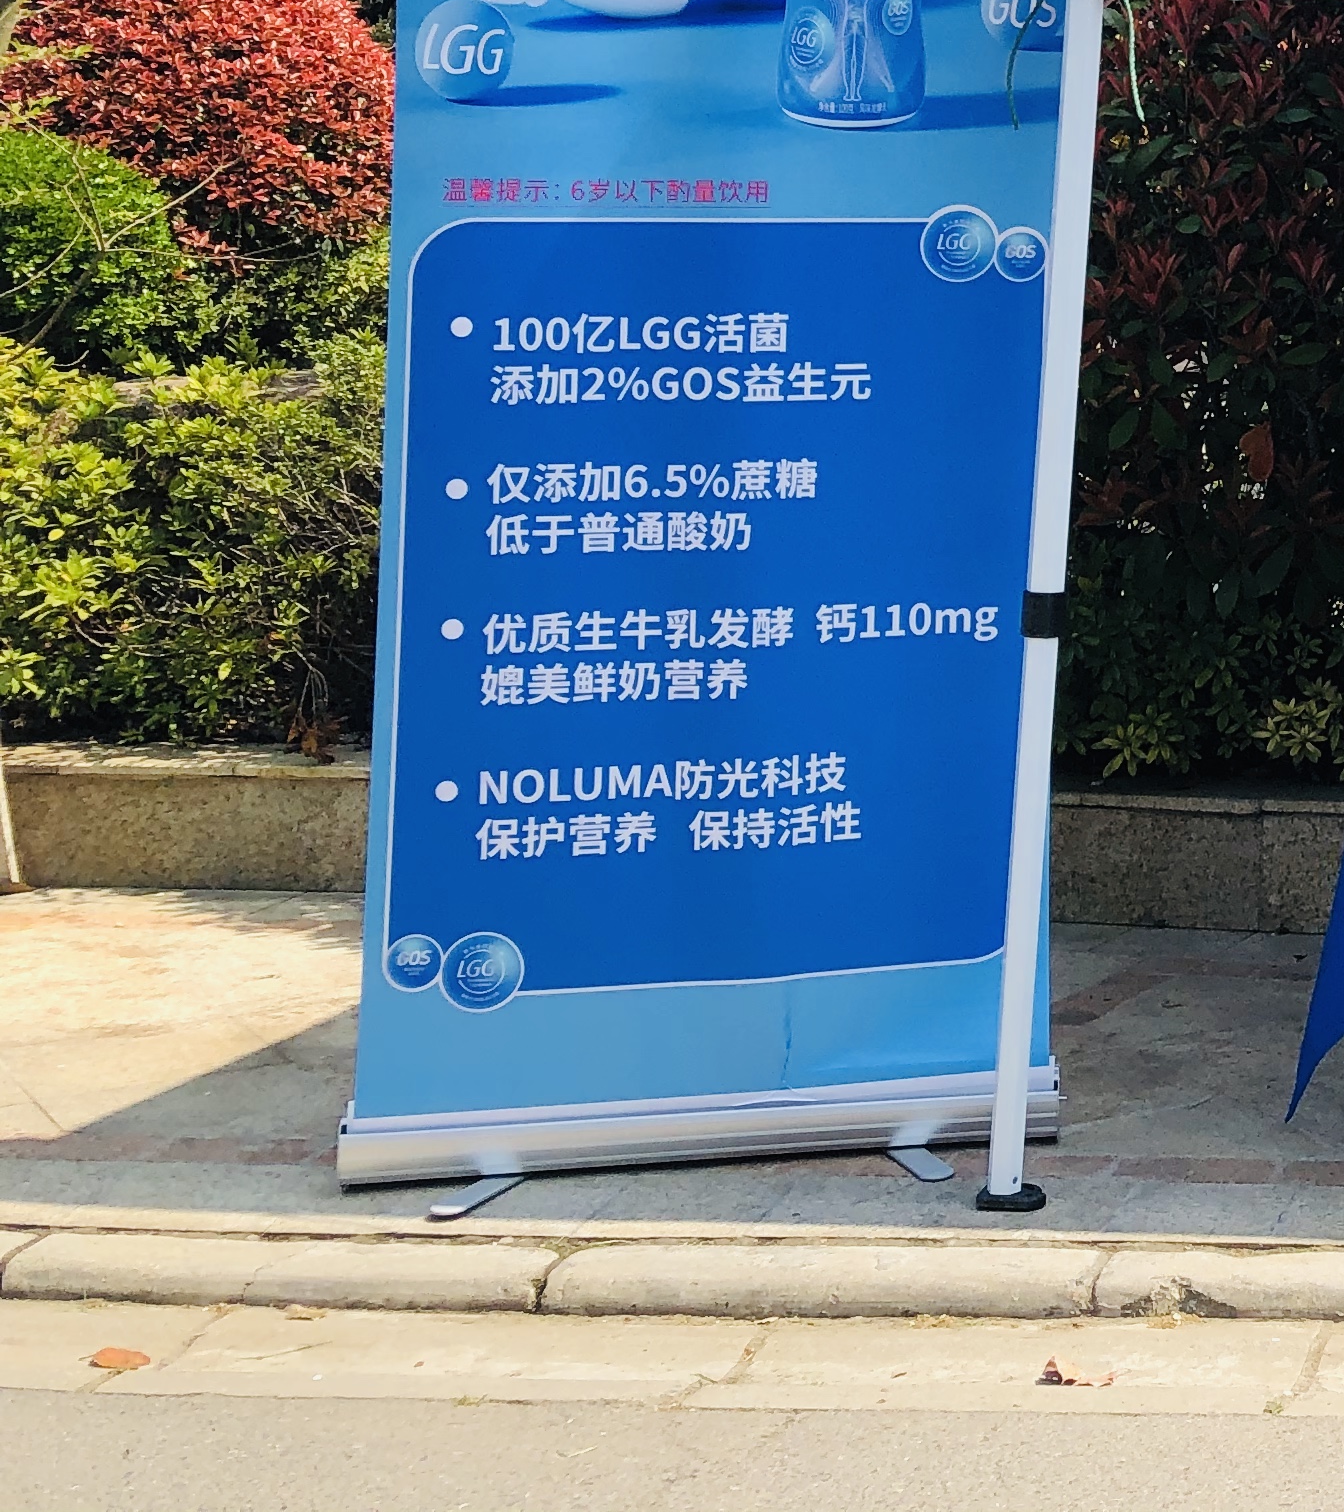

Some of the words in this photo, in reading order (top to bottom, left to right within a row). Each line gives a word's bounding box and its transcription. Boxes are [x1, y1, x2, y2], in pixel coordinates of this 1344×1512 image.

[423, 23, 506, 75] LGG
[791, 26, 819, 48] LGG
[491, 313, 790, 354] 100亿LGG活菌
[489, 361, 872, 407] 添加2%GOS益生元
[486, 457, 818, 505] 仅添加6.5%蔗糖
[485, 511, 752, 556] 低于普通酸奶
[481, 605, 795, 655] 优质生牛乳发酵
[815, 601, 999, 645] 钙110mg
[479, 659, 748, 707] 媲美鲜奶营养
[477, 751, 847, 805] NOLUMA防光科技
[474, 811, 657, 861] 保护营养
[688, 800, 862, 852] 保持活性
